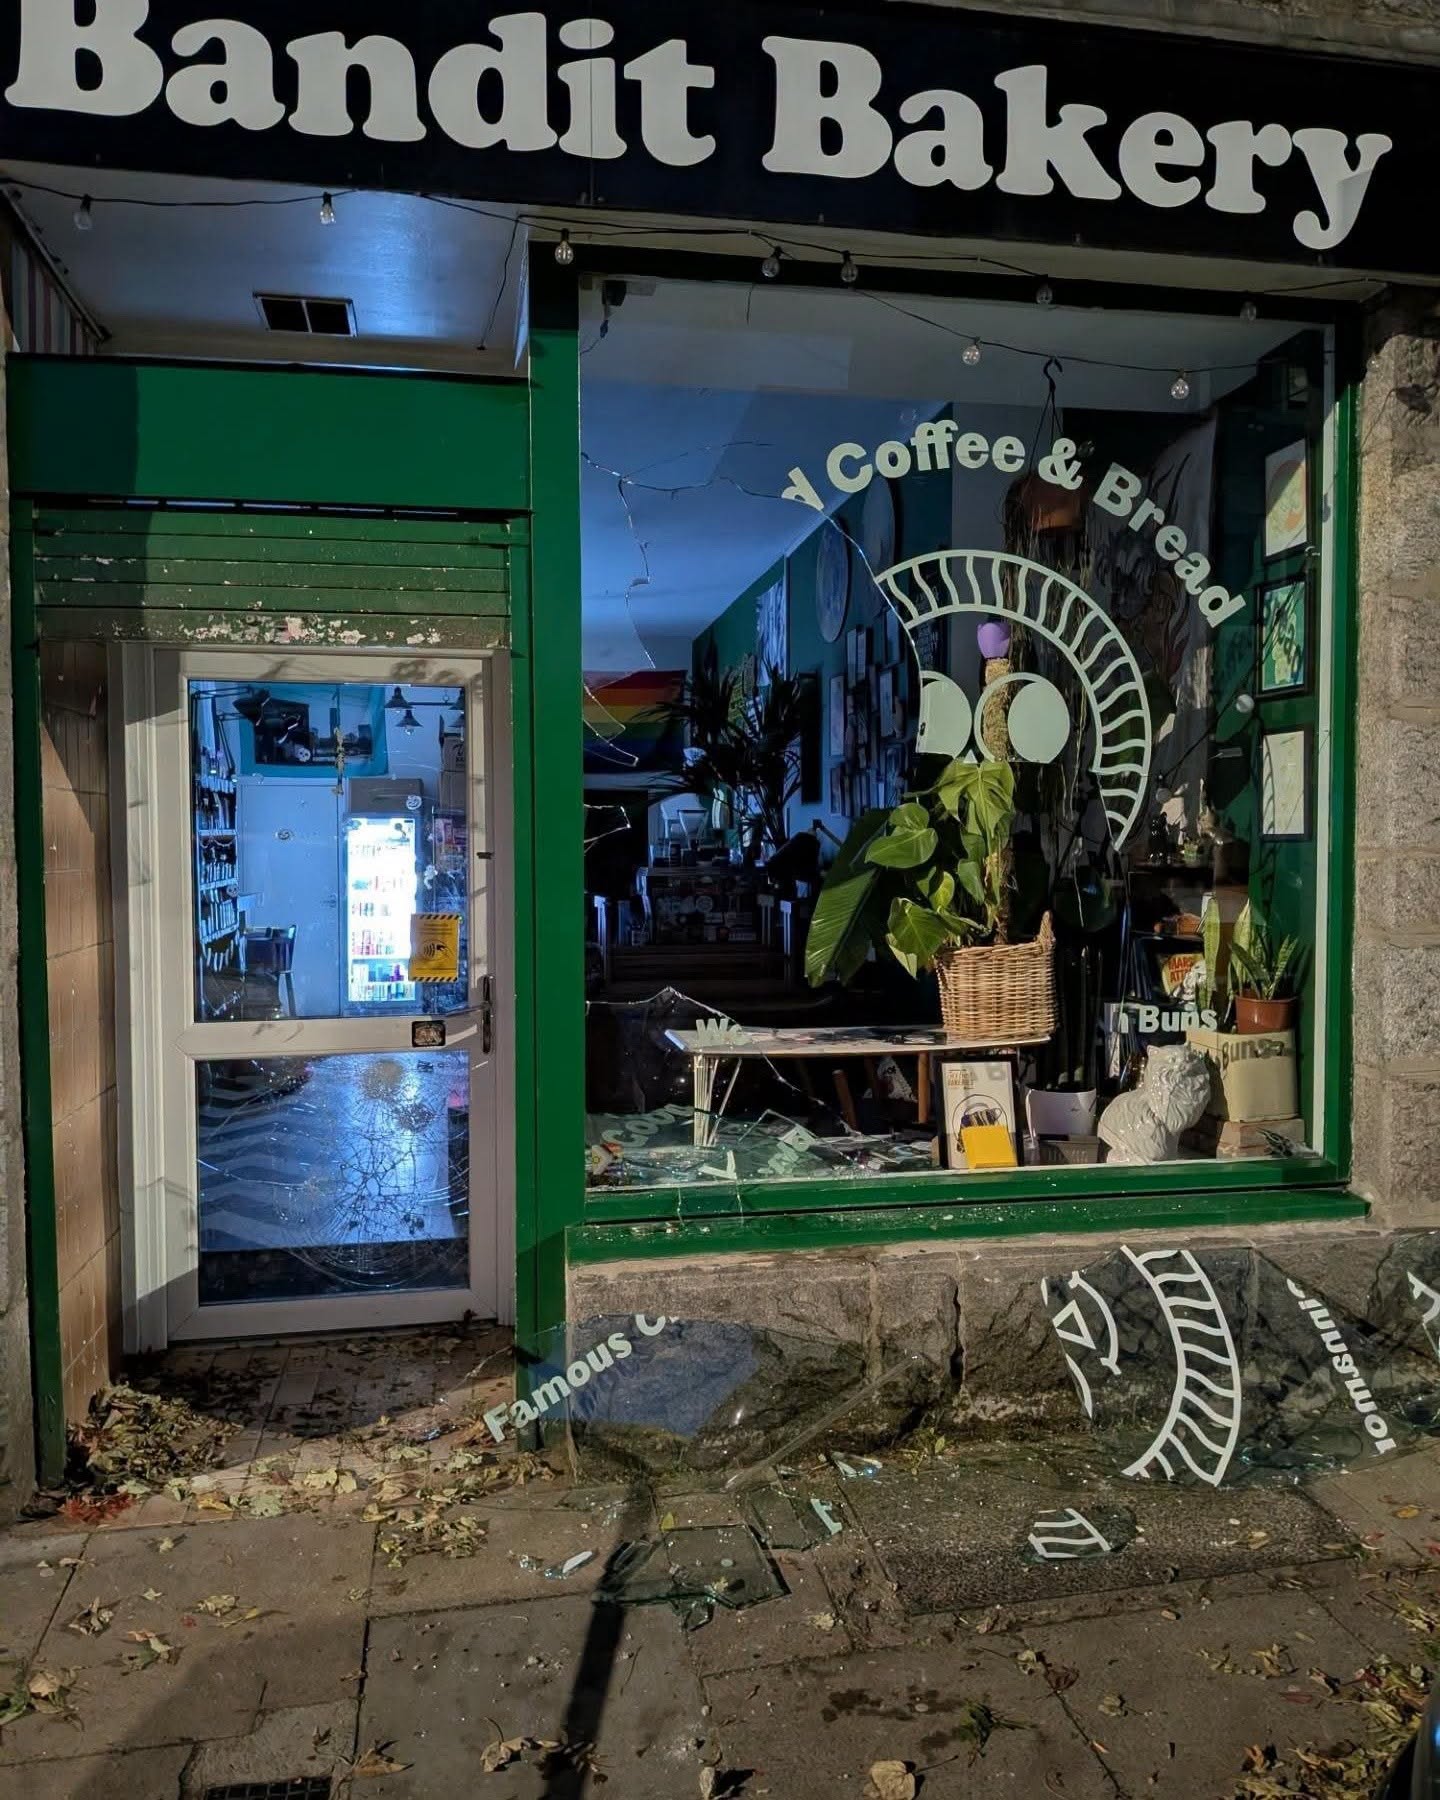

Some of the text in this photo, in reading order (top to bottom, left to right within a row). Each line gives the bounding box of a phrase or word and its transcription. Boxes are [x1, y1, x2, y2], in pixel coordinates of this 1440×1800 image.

[4, 0, 1393, 250] Bandit Bakery
[826, 419, 1026, 494] Coffee
[1038, 437, 1083, 490] &
[1093, 462, 1246, 628] Bread
[1138, 1003, 1218, 1034] Buns
[483, 1332, 632, 1443] Famous
